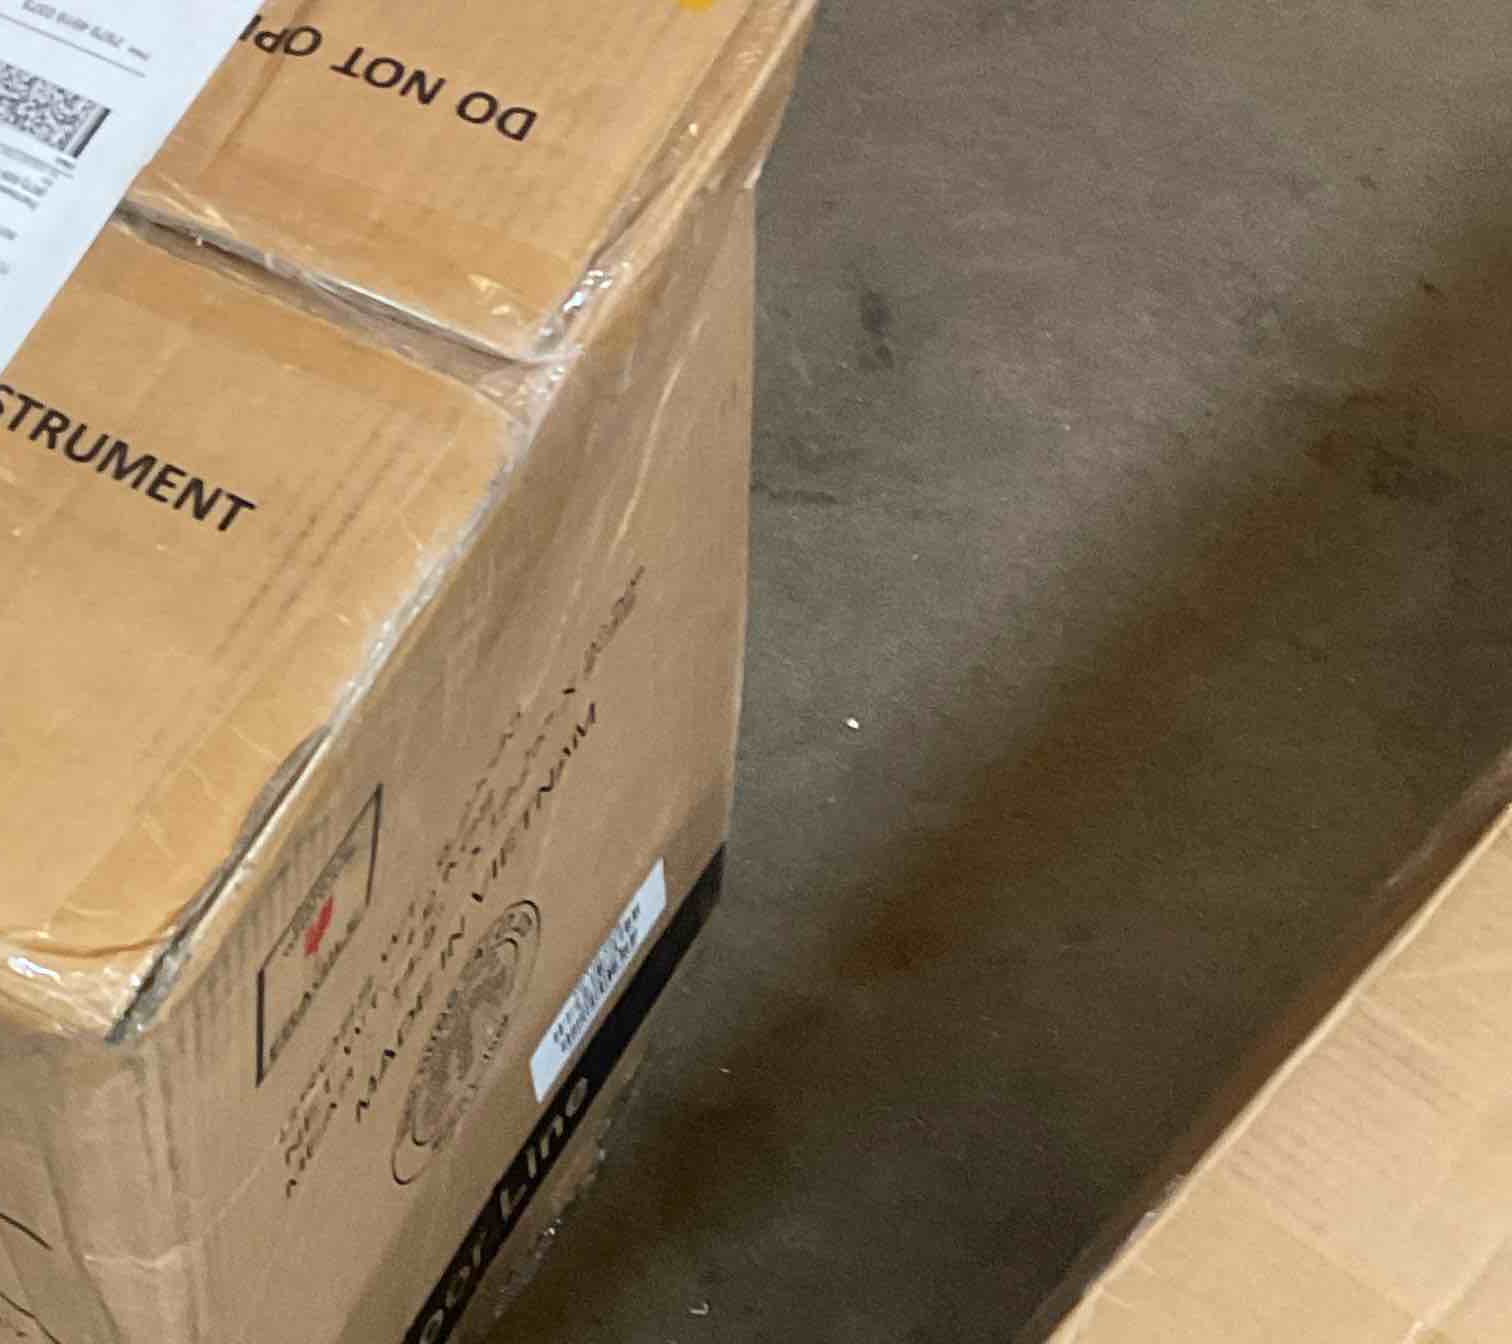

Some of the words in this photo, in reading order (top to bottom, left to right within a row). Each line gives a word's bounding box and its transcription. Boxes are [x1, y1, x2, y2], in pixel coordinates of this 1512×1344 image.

[330, 47, 446, 105] NOT
[456, 91, 537, 142] DO
[355, 969, 432, 1123] MADE
[472, 701, 598, 904] VIETNAM
[499, 1076, 589, 1222] Line
